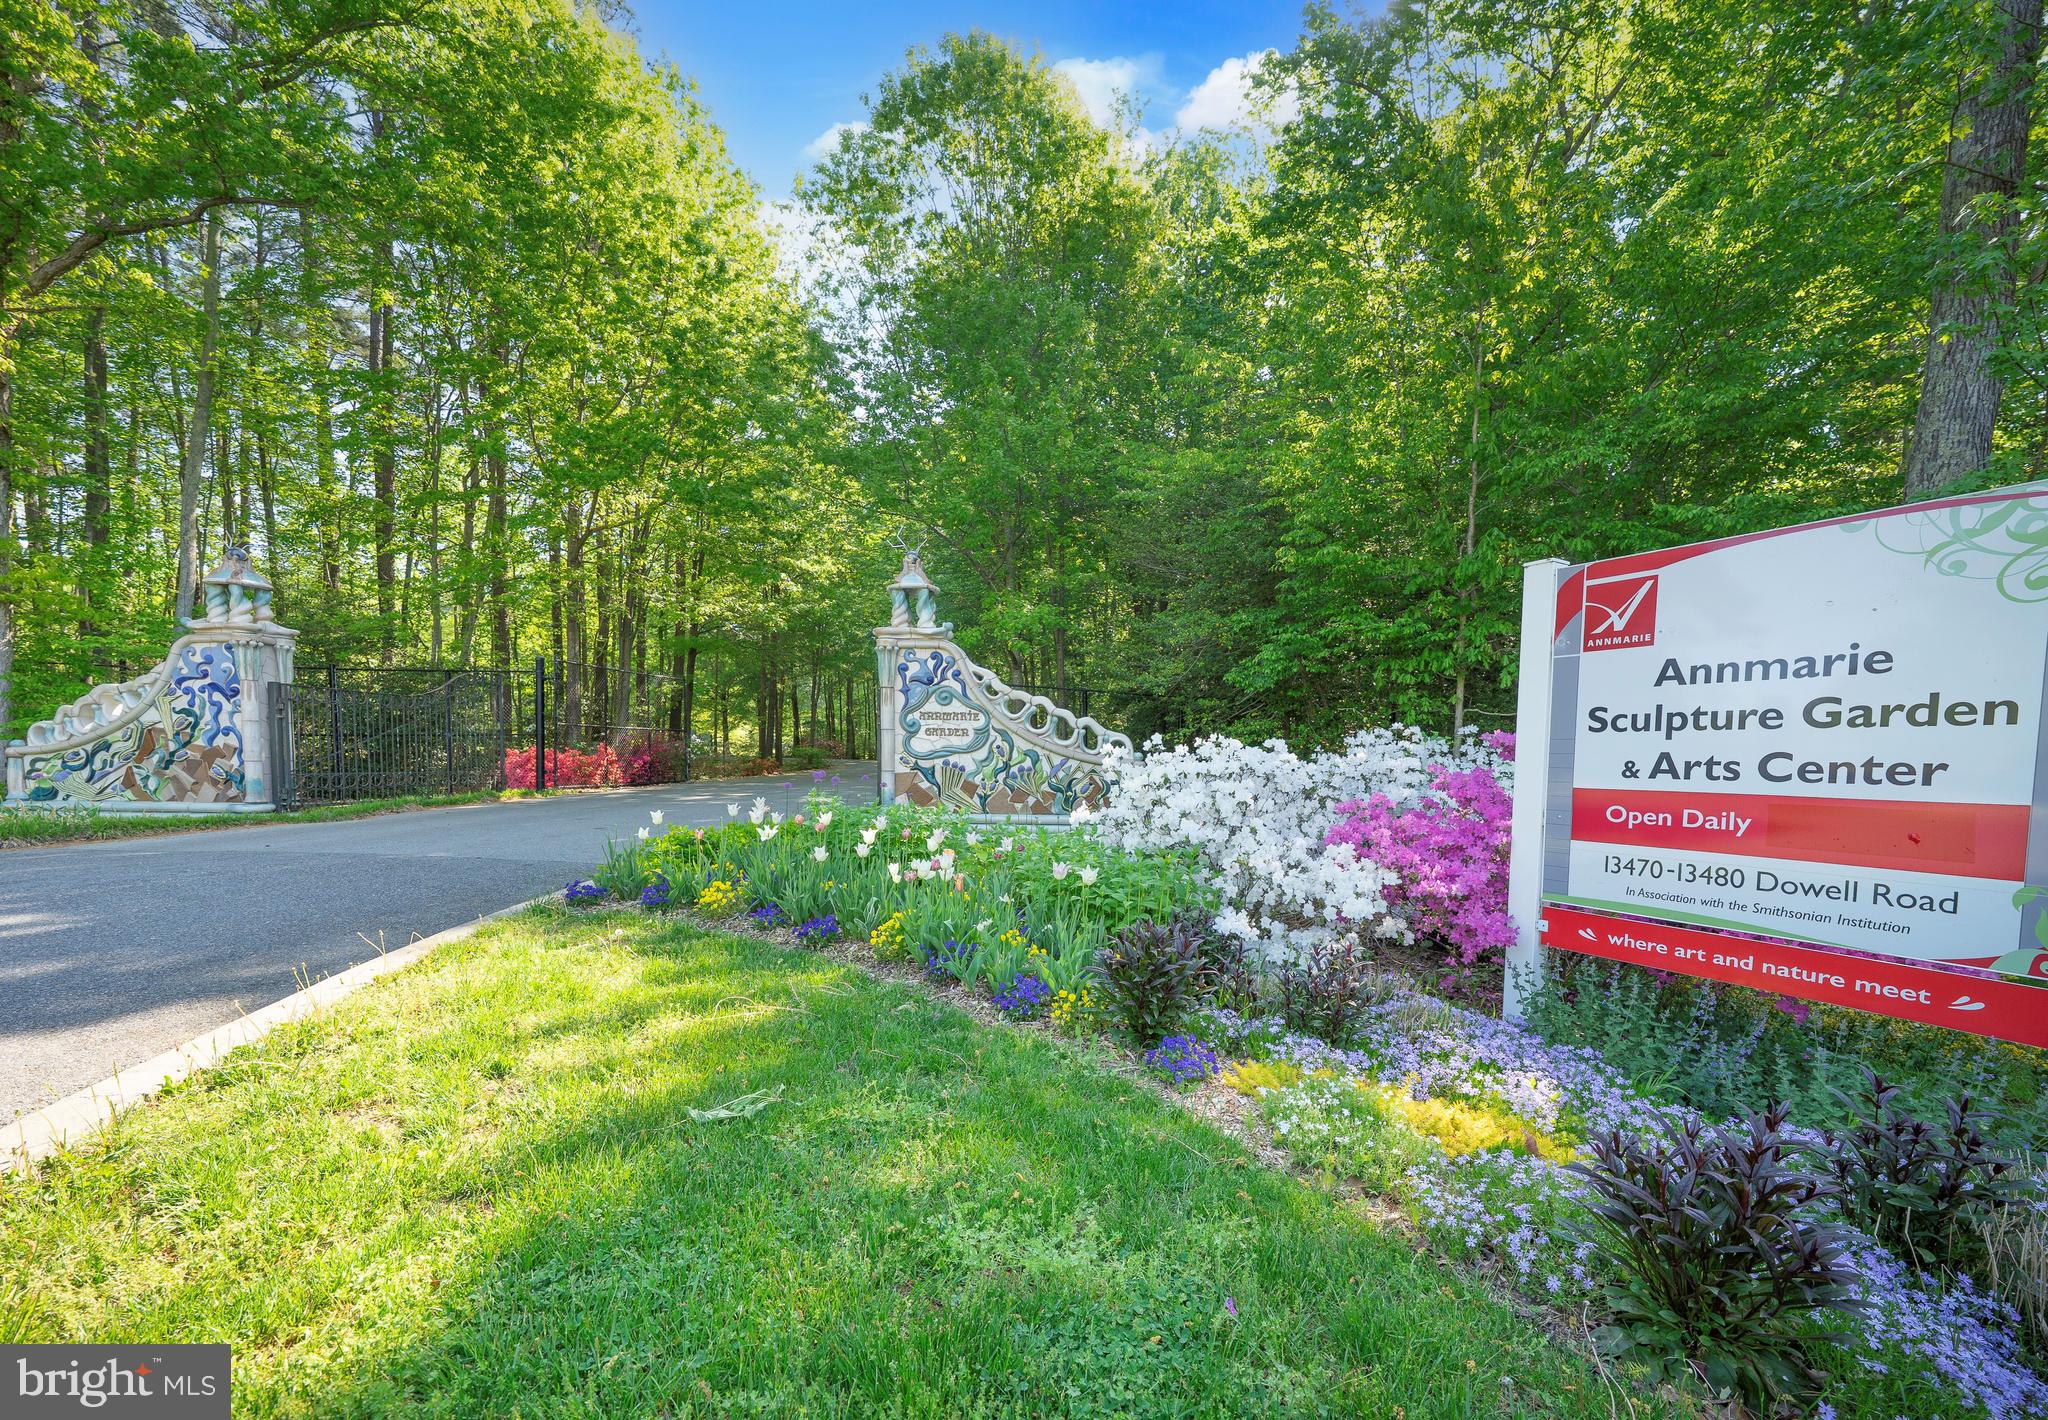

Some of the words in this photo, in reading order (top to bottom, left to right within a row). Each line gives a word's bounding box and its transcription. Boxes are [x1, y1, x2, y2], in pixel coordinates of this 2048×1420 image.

[1587, 633, 1652, 648] ANNMARIE
[1653, 642, 1894, 687] Annmarie
[1588, 704, 1784, 740] Sculpture
[1802, 692, 2019, 729] Garden
[1621, 760, 1640, 779] &
[1648, 751, 1741, 782] Arts
[1757, 751, 1949, 787] Center
[1605, 805, 1672, 829] Open
[1682, 808, 1752, 837] Daily
[1604, 855, 1745, 889] 13470-13480
[1756, 870, 1857, 903] Dowell
[1873, 883, 1959, 915] Road
[1625, 886, 1636, 897] In
[1637, 887, 1697, 906] Association
[1700, 896, 1724, 909] with
[1728, 898, 1748, 912] the
[1752, 902, 1832, 924] Smithsonian
[1838, 913, 1911, 935] Institution
[1607, 932, 1668, 954] where
[1674, 945, 1706, 962] art
[1712, 950, 1754, 971] and
[1762, 962, 1845, 988] nature
[1855, 977, 1931, 1005] meet
